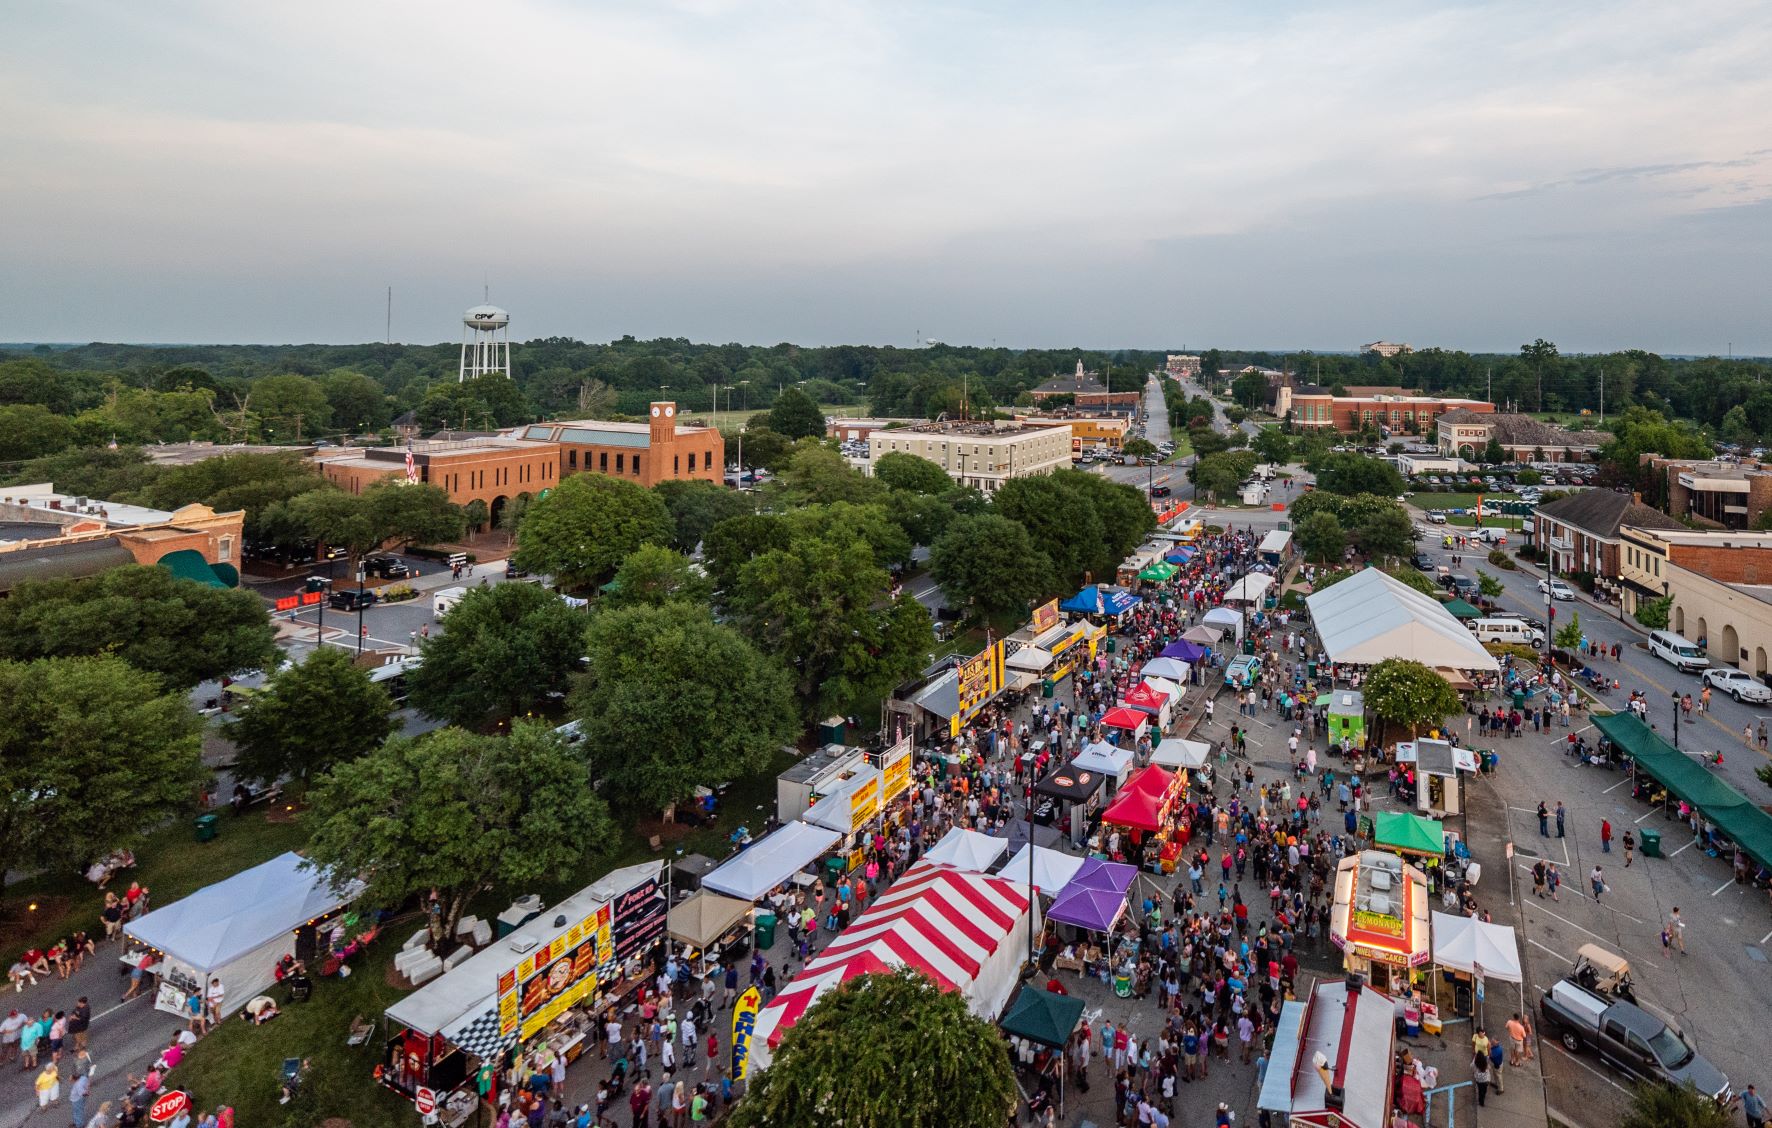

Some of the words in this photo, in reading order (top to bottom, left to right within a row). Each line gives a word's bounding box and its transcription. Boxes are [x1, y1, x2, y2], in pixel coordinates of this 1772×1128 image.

[1384, 952, 1407, 965] CAKES
[733, 1011, 755, 1079] SHIRTS
[153, 1096, 183, 1116] STOP
